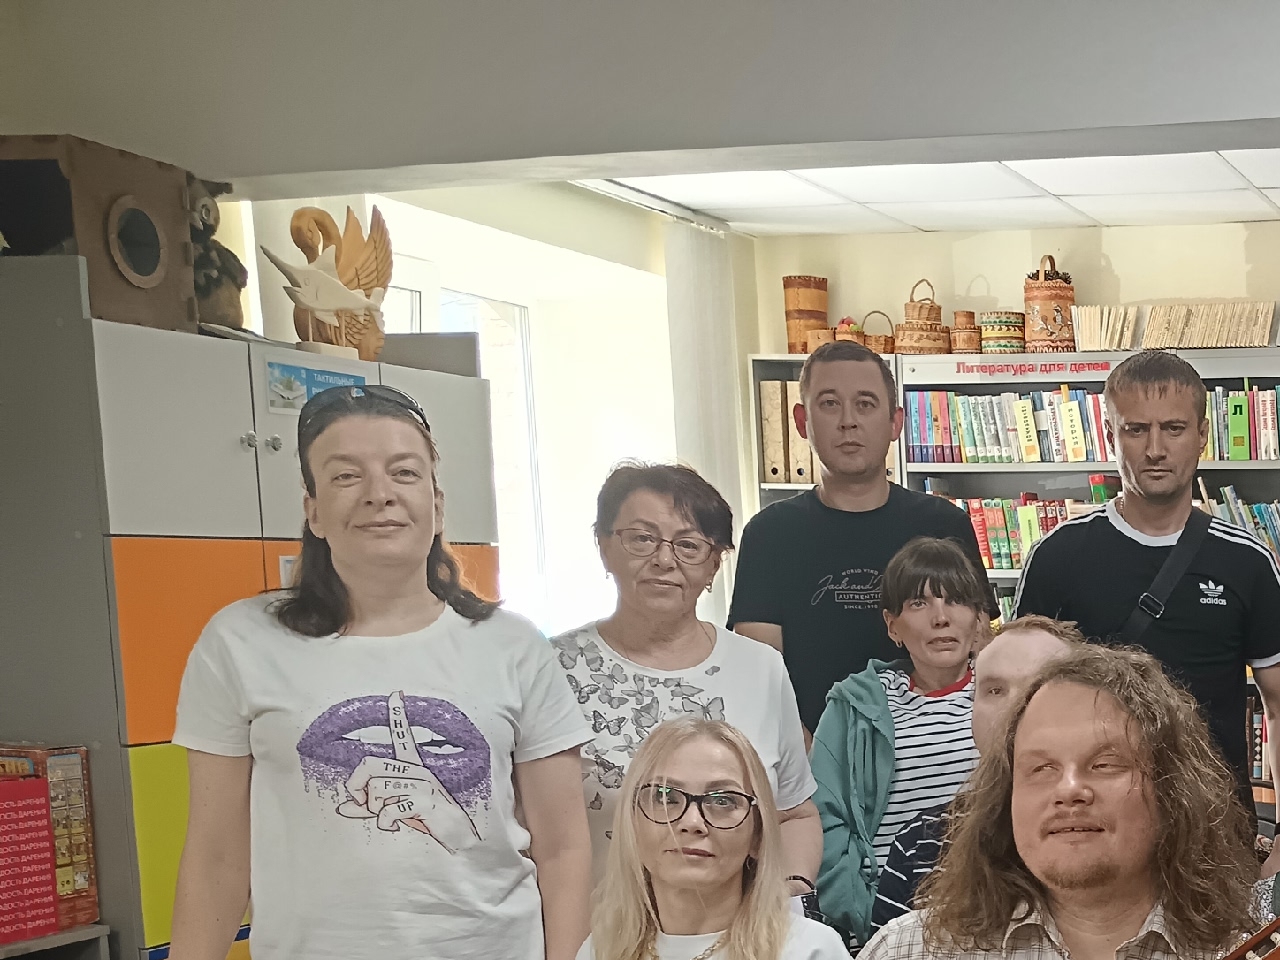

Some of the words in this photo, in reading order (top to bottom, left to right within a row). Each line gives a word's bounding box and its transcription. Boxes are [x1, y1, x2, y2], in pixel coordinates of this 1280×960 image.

[955, 362, 1035, 376] Литература
[1039, 363, 1065, 374] для
[314, 372, 355, 386] ТАКТИЛЬНЫЕ
[1232, 403, 1244, 416] Л
[1199, 597, 1227, 606] adidas
[383, 762, 410, 775] THE
[397, 800, 415, 813] UP
